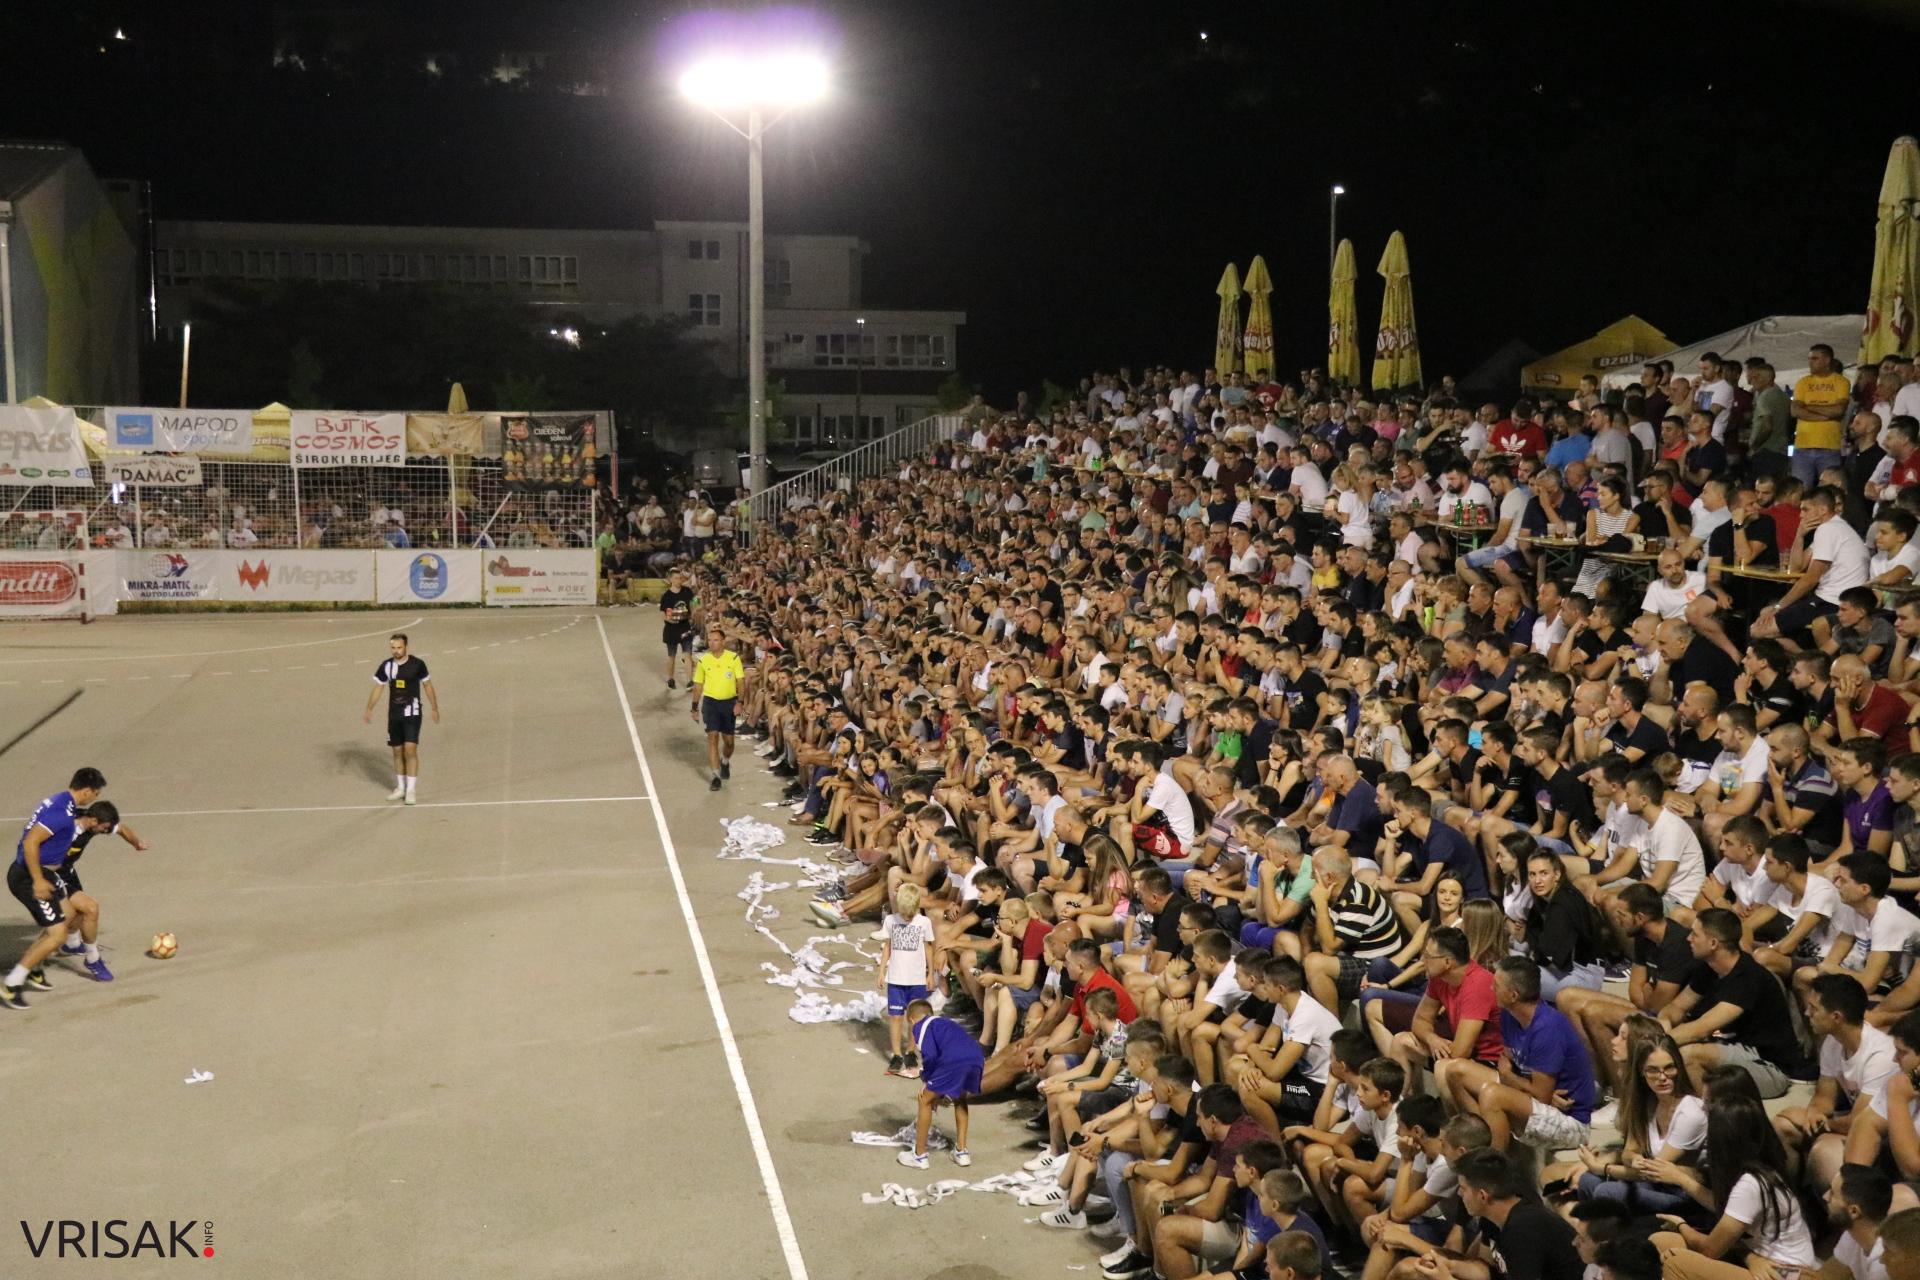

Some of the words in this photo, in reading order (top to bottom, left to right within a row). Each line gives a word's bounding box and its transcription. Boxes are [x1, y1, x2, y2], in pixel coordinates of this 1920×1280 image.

[1807, 383, 1835, 392] KAPPA
[162, 416, 239, 432] MAPOD
[183, 433, 219, 448] sport
[294, 435, 401, 450] COSMOS
[295, 453, 345, 465] ŠIROKI
[350, 454, 401, 465] BRIJEG
[128, 580, 191, 591] MIKRA-MATIC
[278, 565, 359, 591] Mepas
